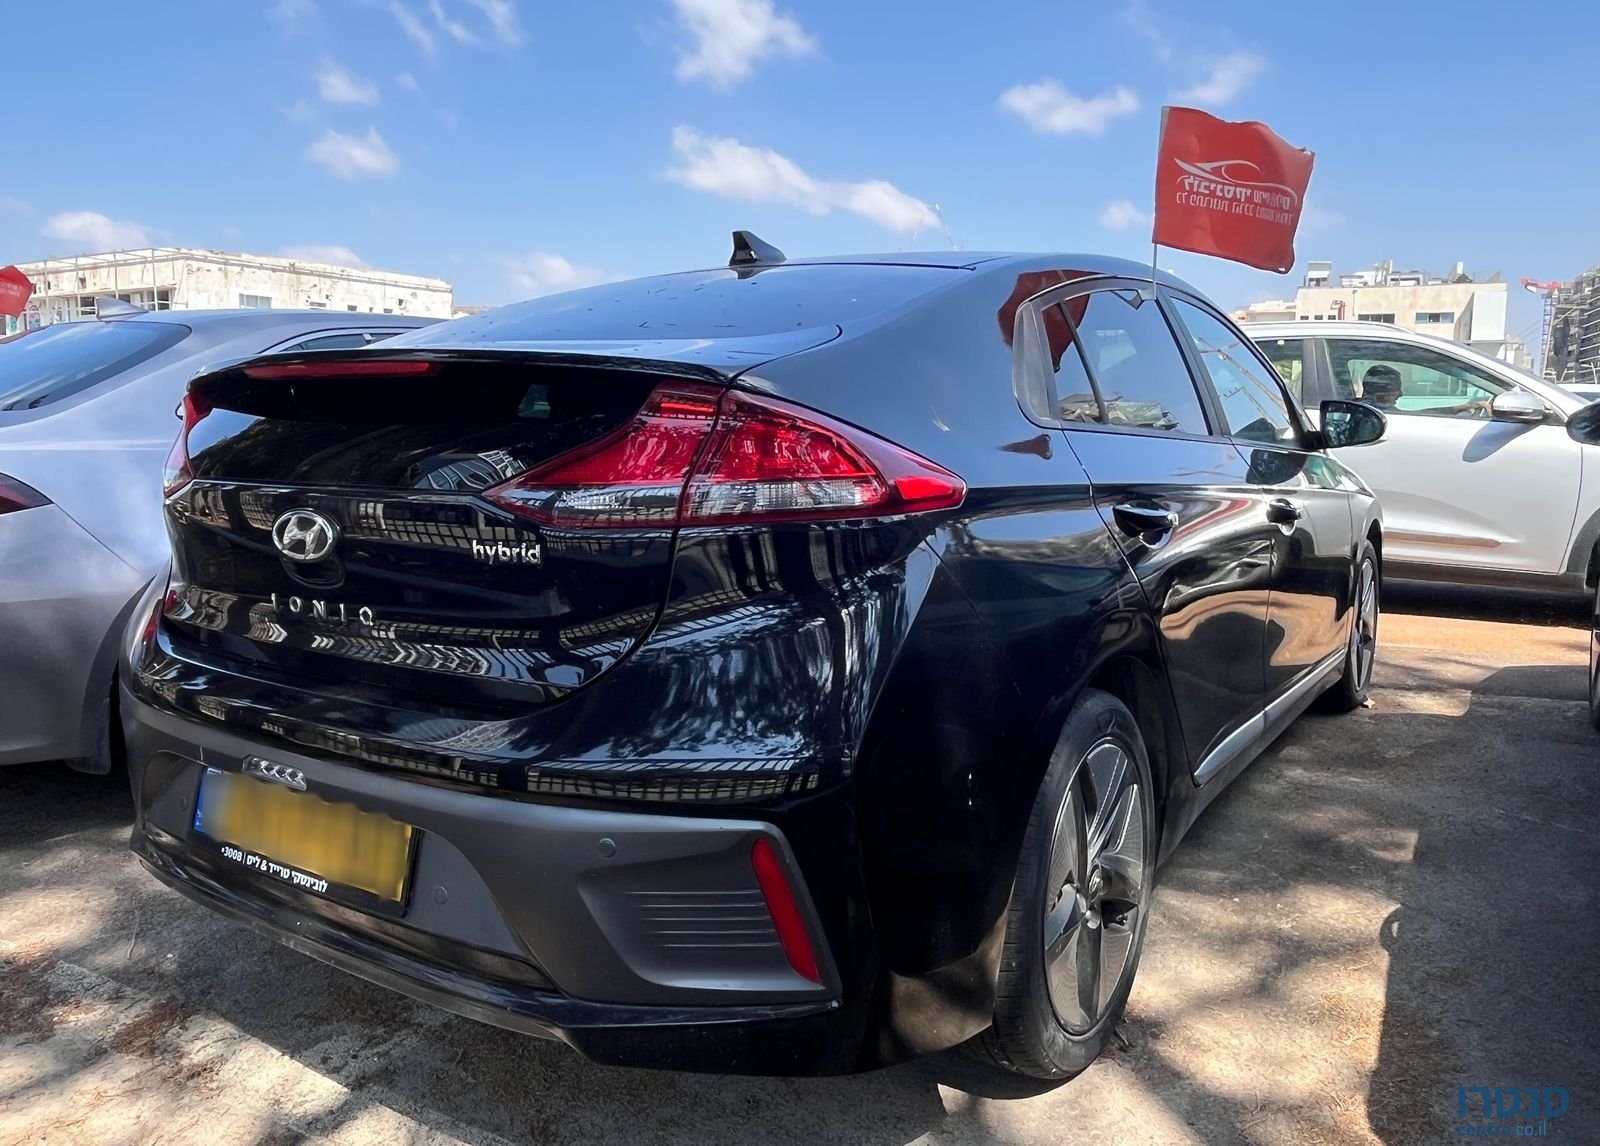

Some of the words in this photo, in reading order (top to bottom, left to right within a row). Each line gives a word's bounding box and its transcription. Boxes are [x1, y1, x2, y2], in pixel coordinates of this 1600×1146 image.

[472, 540, 541, 565] hybrid
[270, 592, 374, 626] IONIQ
[291, 870, 329, 893] לובינסקי
